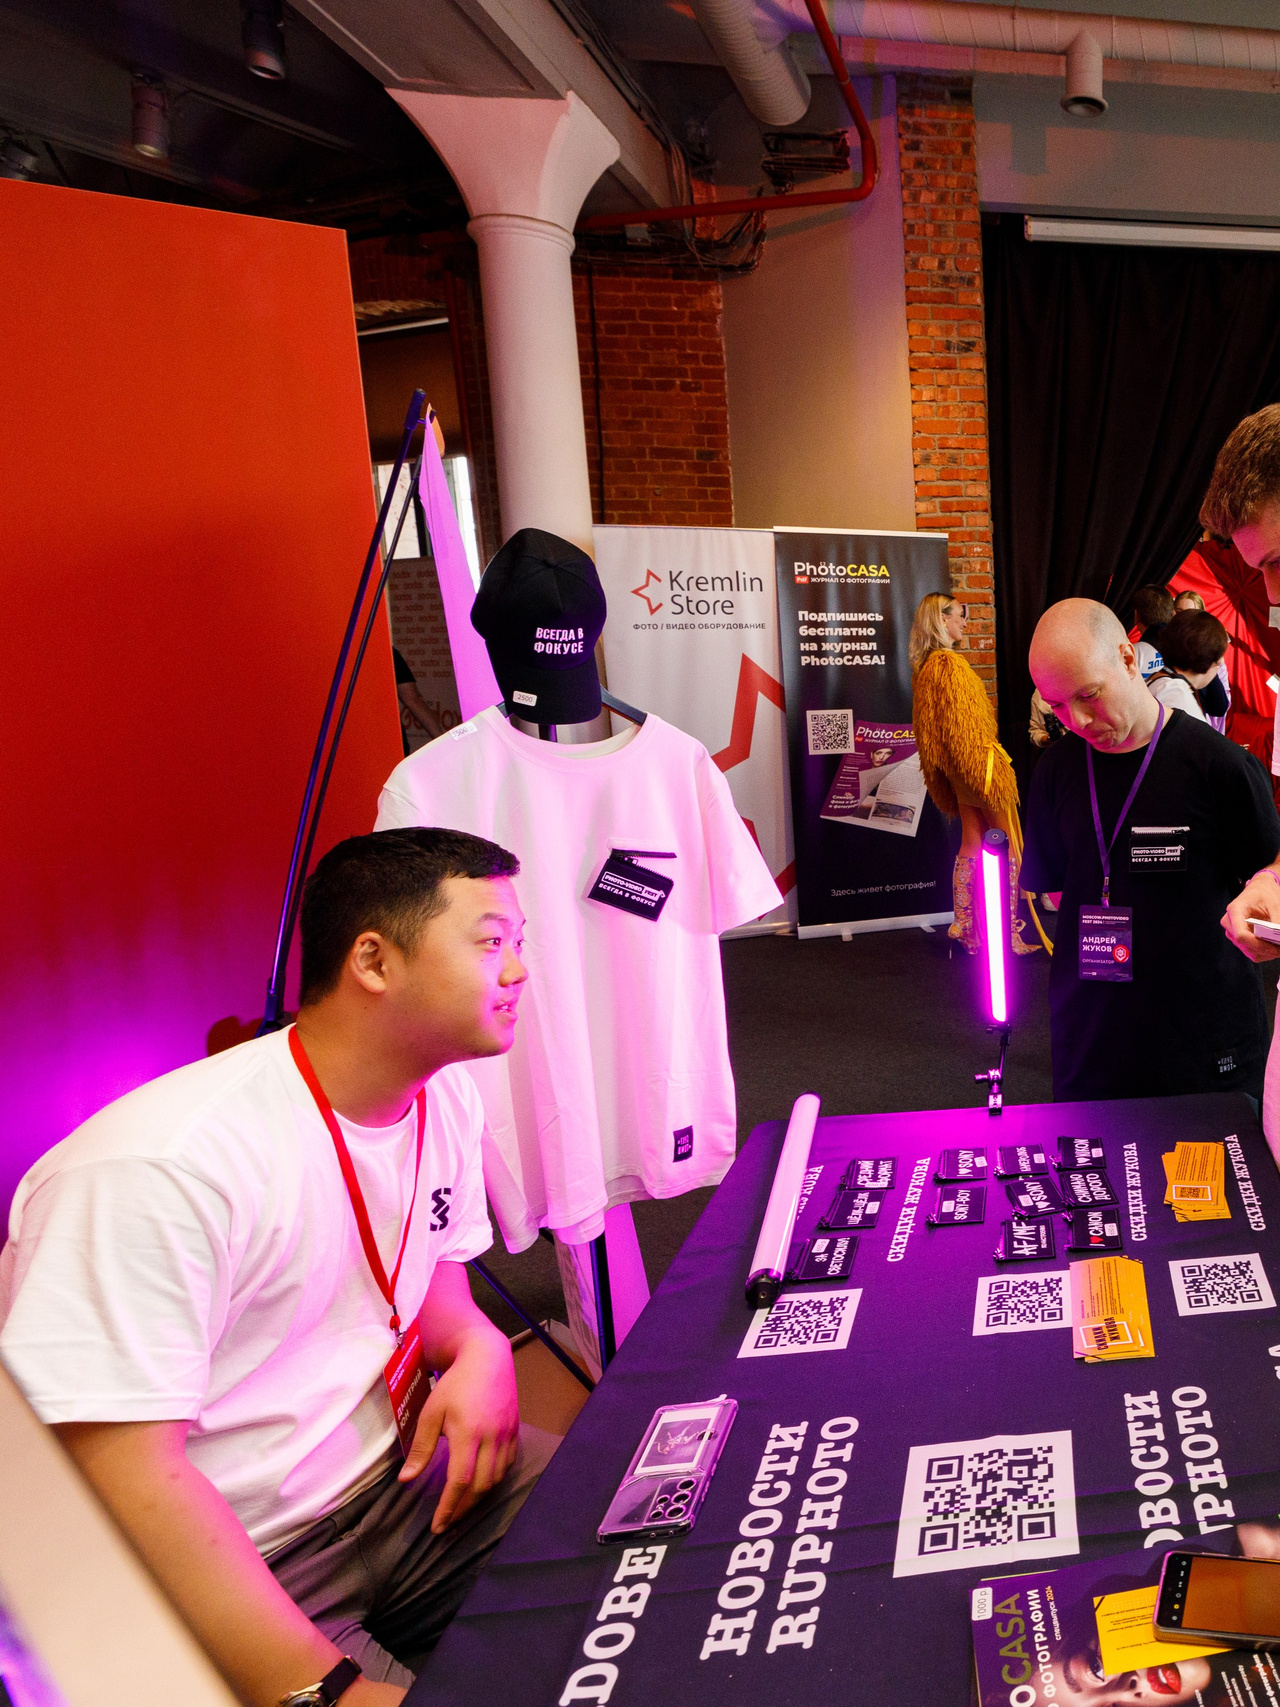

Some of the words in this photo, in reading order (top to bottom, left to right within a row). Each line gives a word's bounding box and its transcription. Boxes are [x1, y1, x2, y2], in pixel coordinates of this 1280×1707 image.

[668, 570, 763, 592] Kremlin
[793, 562, 890, 577] PhotoCASA
[671, 594, 734, 615] Store
[798, 610, 884, 622] Подпишись
[535, 627, 575, 641] ВСЕГДА
[577, 627, 584, 639] В
[665, 622, 696, 630] ВИДЕО
[697, 622, 766, 630] ОБОРУДОВАНИЕ
[798, 625, 876, 636] бесплатно
[533, 641, 584, 655] ФОКУСЕ
[800, 642, 818, 651] на
[821, 641, 877, 653] журнал
[800, 655, 885, 666] PhotoCASA!
[517, 694, 534, 702] 2500
[598, 883, 623, 895] ВСЕГДА
[630, 894, 656, 907] ФОКУСЕ
[857, 886, 883, 894] живет
[884, 881, 937, 893] фотография!
[1082, 936, 1117, 944] АНДРЕЙ
[1082, 944, 1113, 952] ЖУКОВ
[958, 1150, 974, 1168] SONY
[1123, 1142, 1142, 1188] ЖУКОВА
[1224, 1134, 1251, 1179] ЖУКОВА
[1023, 1181, 1048, 1201] SONY
[1070, 1173, 1093, 1203] СНИМАЮ
[1086, 1173, 1111, 1201] ДОРОГО
[887, 1206, 918, 1262] СКИДКИ
[904, 1157, 931, 1205] ЖУКОВА
[953, 1189, 971, 1221] SONY-BOY
[1127, 1189, 1148, 1242] СКИДКИ
[1238, 1180, 1266, 1231] СКИДКИ
[1087, 1211, 1104, 1237] CANON
[1012, 1221, 1039, 1256] AF/MF
[814, 1253, 829, 1263] ЗА
[1091, 1326, 1109, 1350] СКИДКИ
[1103, 1316, 1121, 1342] ЖУКОВА
[397, 1368, 422, 1420] ДМИТРИЙ
[400, 1409, 410, 1430] ЮН
[1124, 1390, 1184, 1549] ВОСТИ
[1171, 1385, 1236, 1535] PHOTO
[699, 1421, 809, 1661] НОВОСТИ
[766, 1416, 860, 1654] RUPHOTO
[1045, 1585, 1055, 1602] 2024
[977, 1598, 987, 1619] 1000
[559, 1544, 668, 1707] DOBE
[1048, 1602, 1062, 1641] спецвыпуск
[1026, 1589, 1057, 1699] ФОТОГРАФИИ
[1252, 1653, 1275, 1697] фотография
